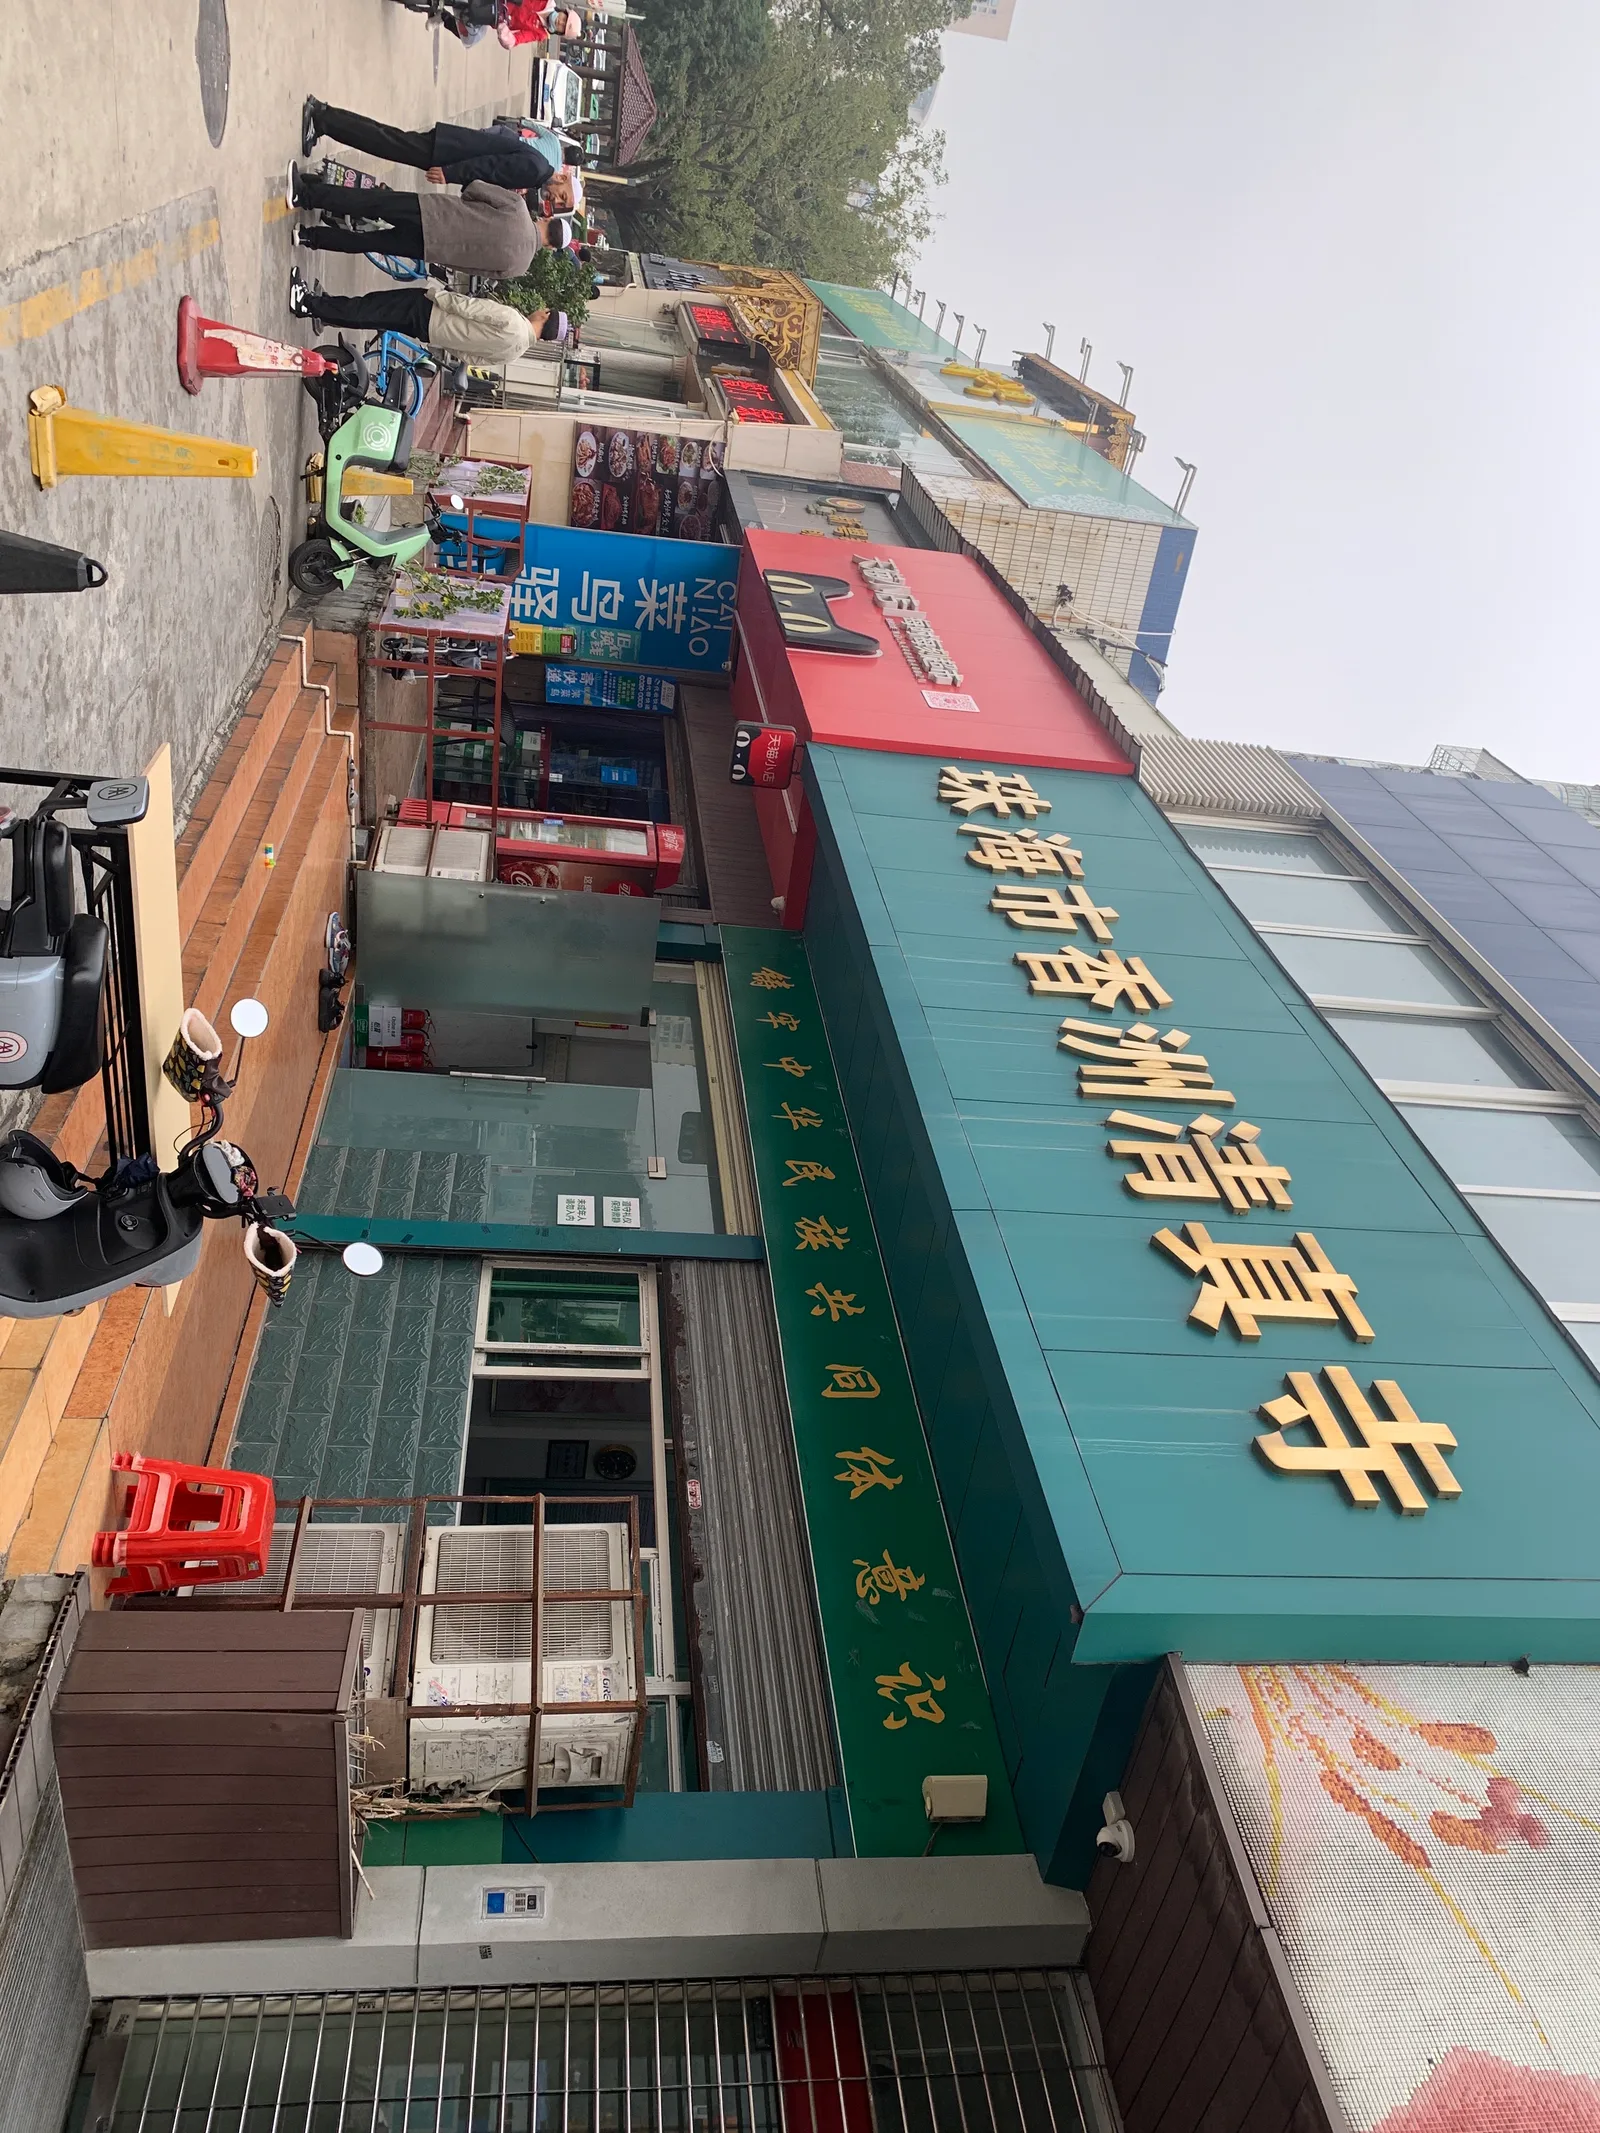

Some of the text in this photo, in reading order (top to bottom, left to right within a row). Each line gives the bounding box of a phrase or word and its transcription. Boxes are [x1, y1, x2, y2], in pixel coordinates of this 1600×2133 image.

[852, 554, 920, 611] 天猫小店
[901, 617, 964, 687] 每时每刻超市
[762, 733, 782, 783] 天猫小店
[937, 765, 1463, 1517] 珠海市香洲清真寺
[565, 1198, 576, 1222] 请勿入内
[576, 1198, 587, 1222] 未成年人
[748, 966, 947, 1732] 铸牢中华民族共同体意识
